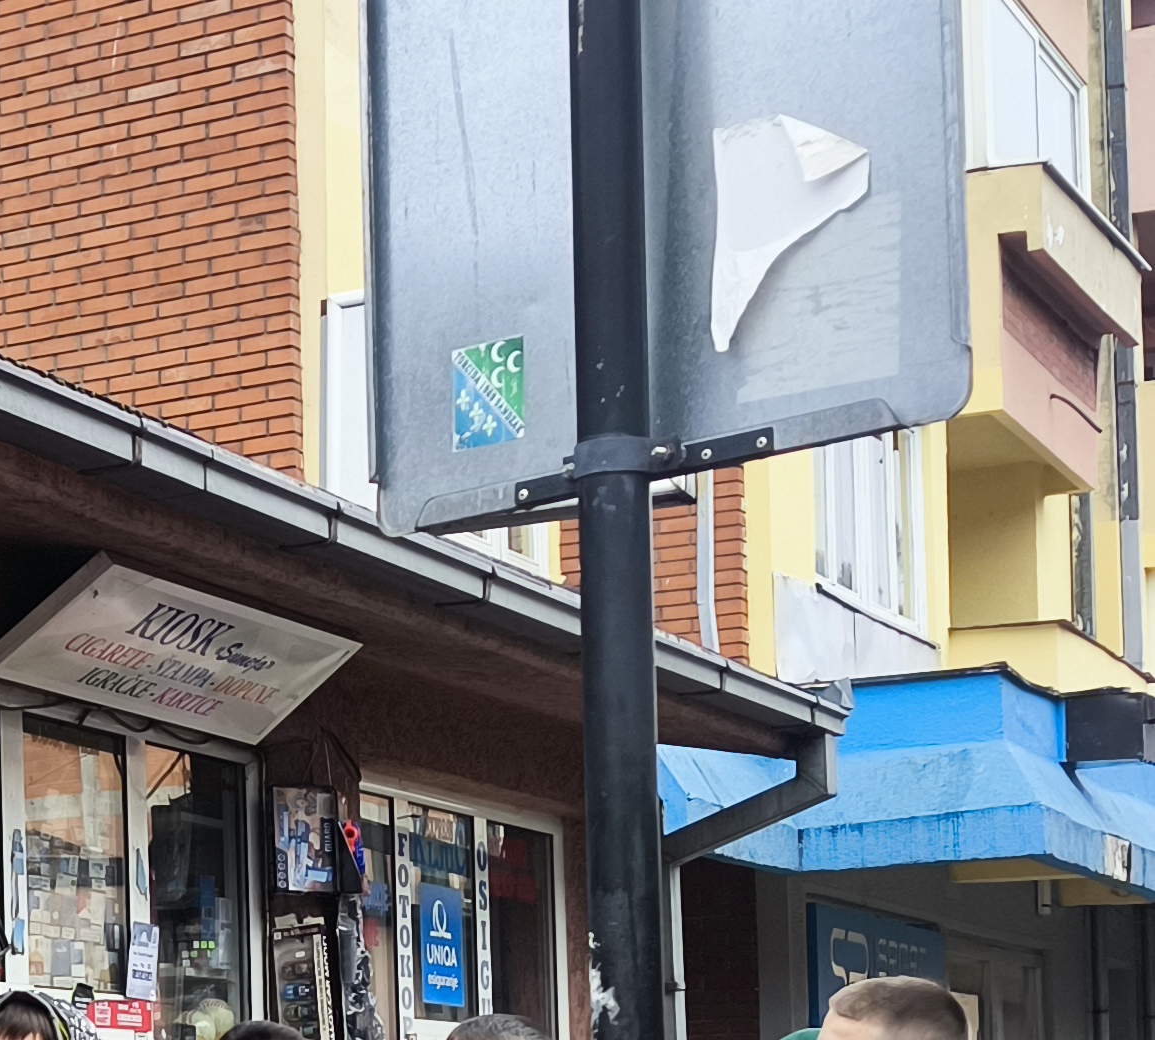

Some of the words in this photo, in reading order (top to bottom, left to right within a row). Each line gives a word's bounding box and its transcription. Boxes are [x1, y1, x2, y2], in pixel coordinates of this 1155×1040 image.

[125, 603, 235, 656] KIOSK
[64, 633, 154, 670] CIGARETE
[149, 654, 216, 688] ŠTAMPA
[213, 675, 280, 706] DOPUNE
[77, 667, 157, 699] IGRAČKE
[152, 687, 224, 717] KARTICE
[324, 822, 333, 853] GUARD
[426, 943, 458, 968] UNIQA
